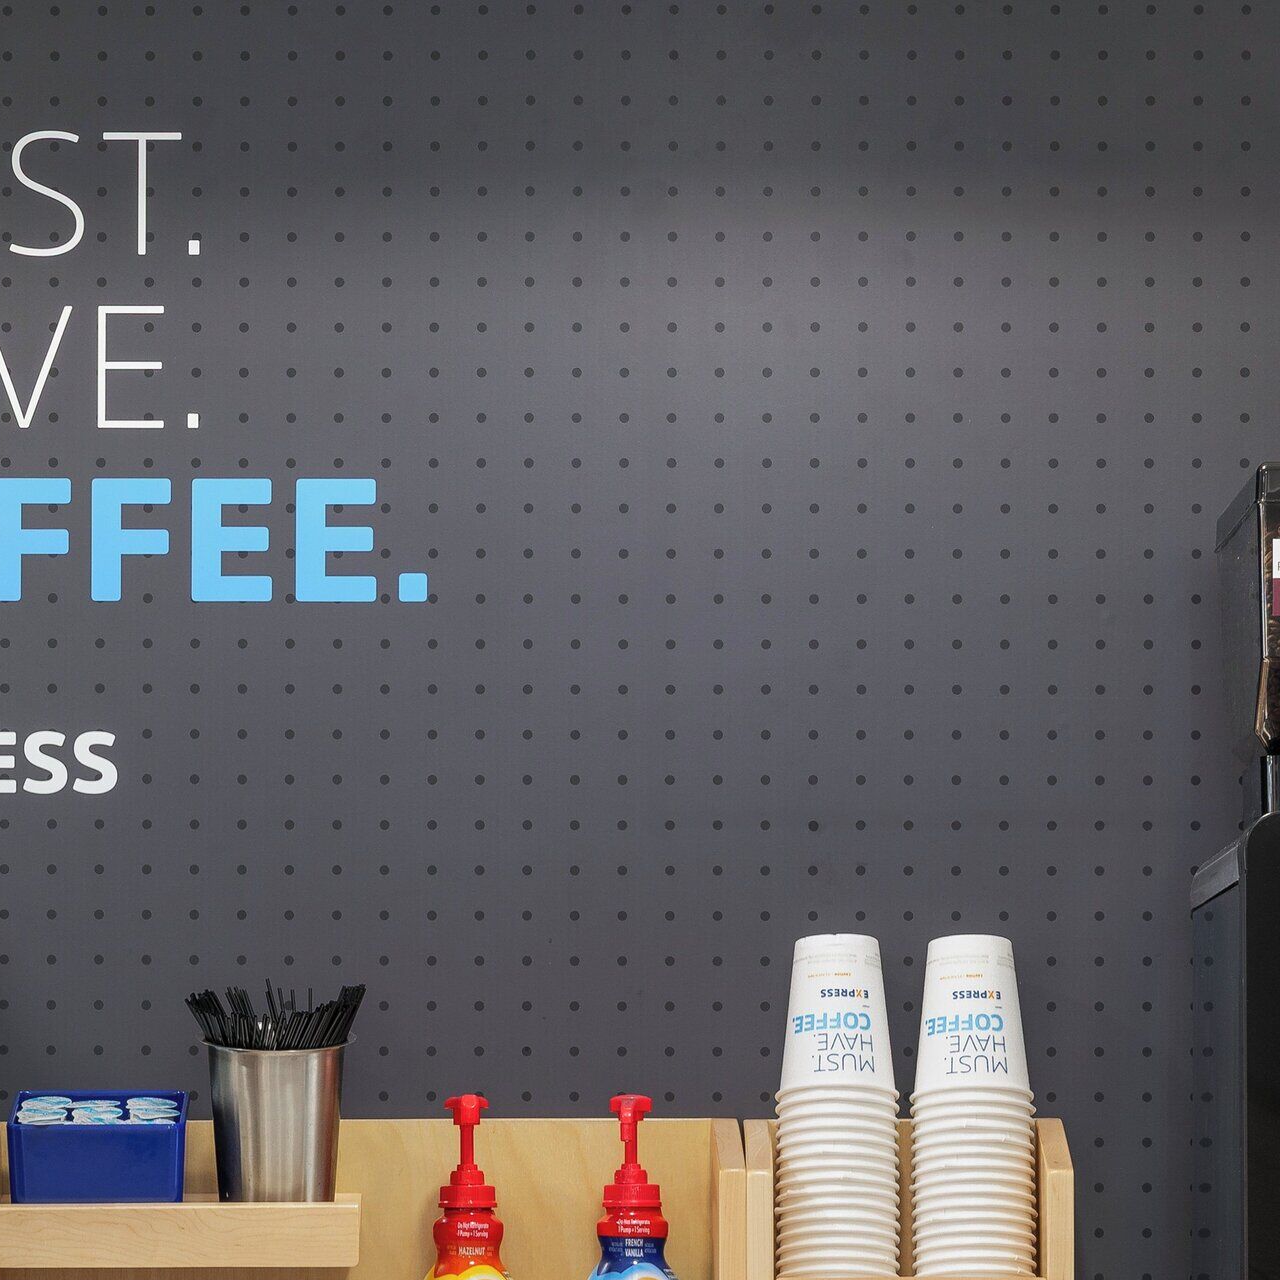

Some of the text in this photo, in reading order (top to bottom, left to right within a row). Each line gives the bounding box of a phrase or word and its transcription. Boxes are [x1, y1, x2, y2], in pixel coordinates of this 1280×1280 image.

[820, 988, 869, 999] EXPRESS
[952, 990, 1001, 1000] EXPRESS
[792, 1011, 872, 1034] COFFEE.
[925, 1013, 1004, 1036] COFFEE.
[813, 1033, 874, 1052] HAVE.
[945, 1034, 1007, 1053] HAVE.
[812, 1053, 875, 1073] MUST.
[945, 1054, 1008, 1074] MUST.
[458, 1246, 485, 1256] HAZELNUT
[625, 1238, 643, 1247] FRENCH
[625, 1248, 644, 1257] VANILLA
